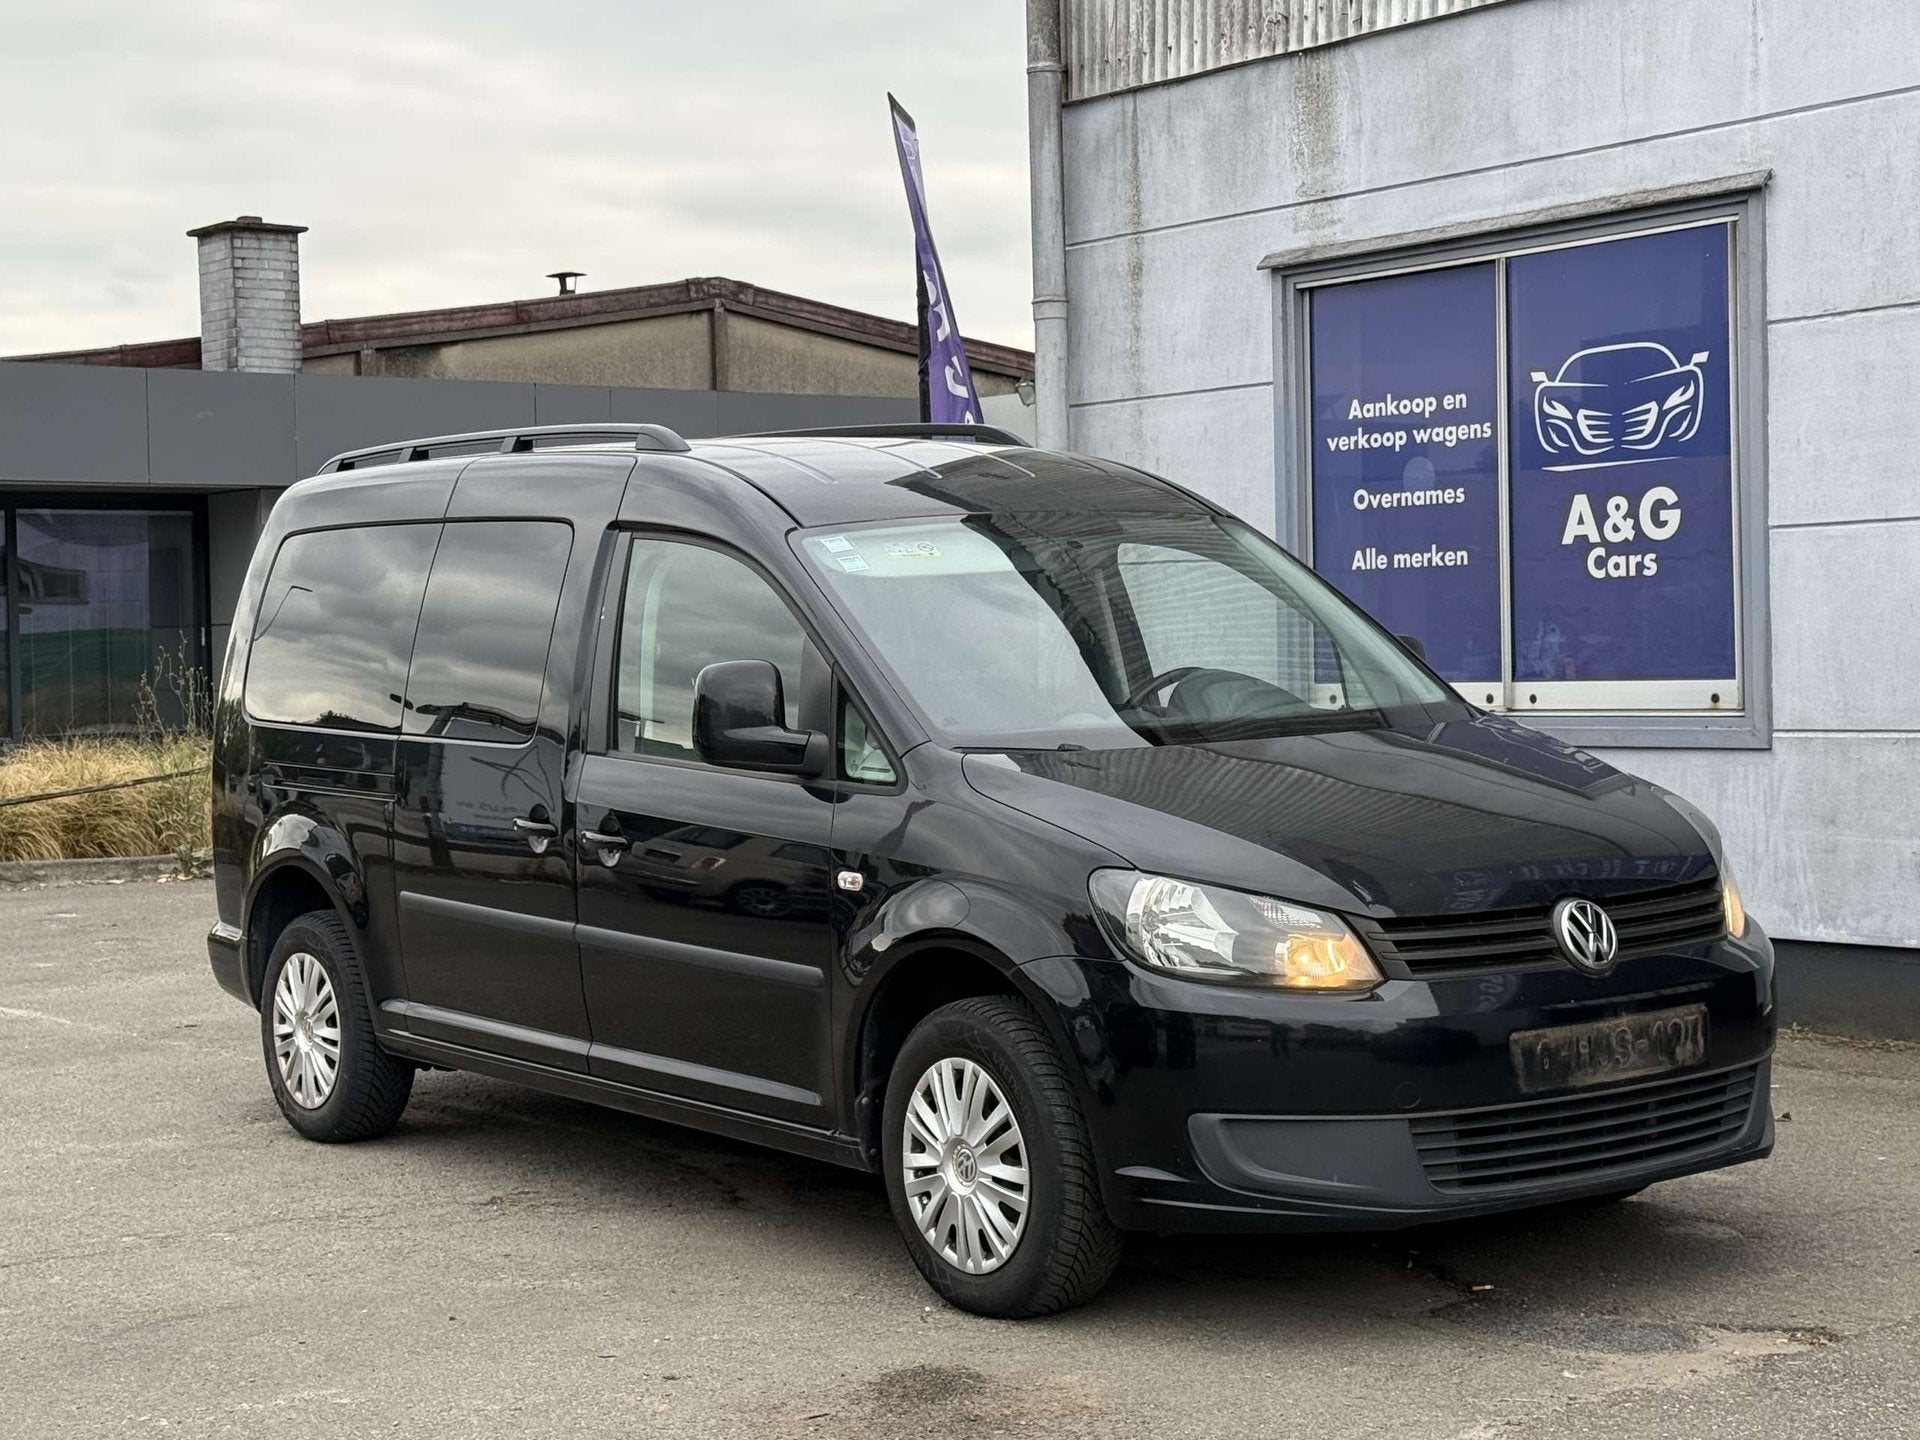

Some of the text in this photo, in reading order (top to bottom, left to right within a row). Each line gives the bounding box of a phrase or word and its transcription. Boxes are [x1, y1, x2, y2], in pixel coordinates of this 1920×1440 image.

[1347, 393, 1467, 420] Aankoop en
[1326, 422, 1492, 452] verkoop wagens
[1353, 487, 1466, 511] Overnames
[1561, 486, 1682, 545] A&G
[1351, 543, 1468, 571] Alle merken
[1587, 546, 1658, 579] Cars
